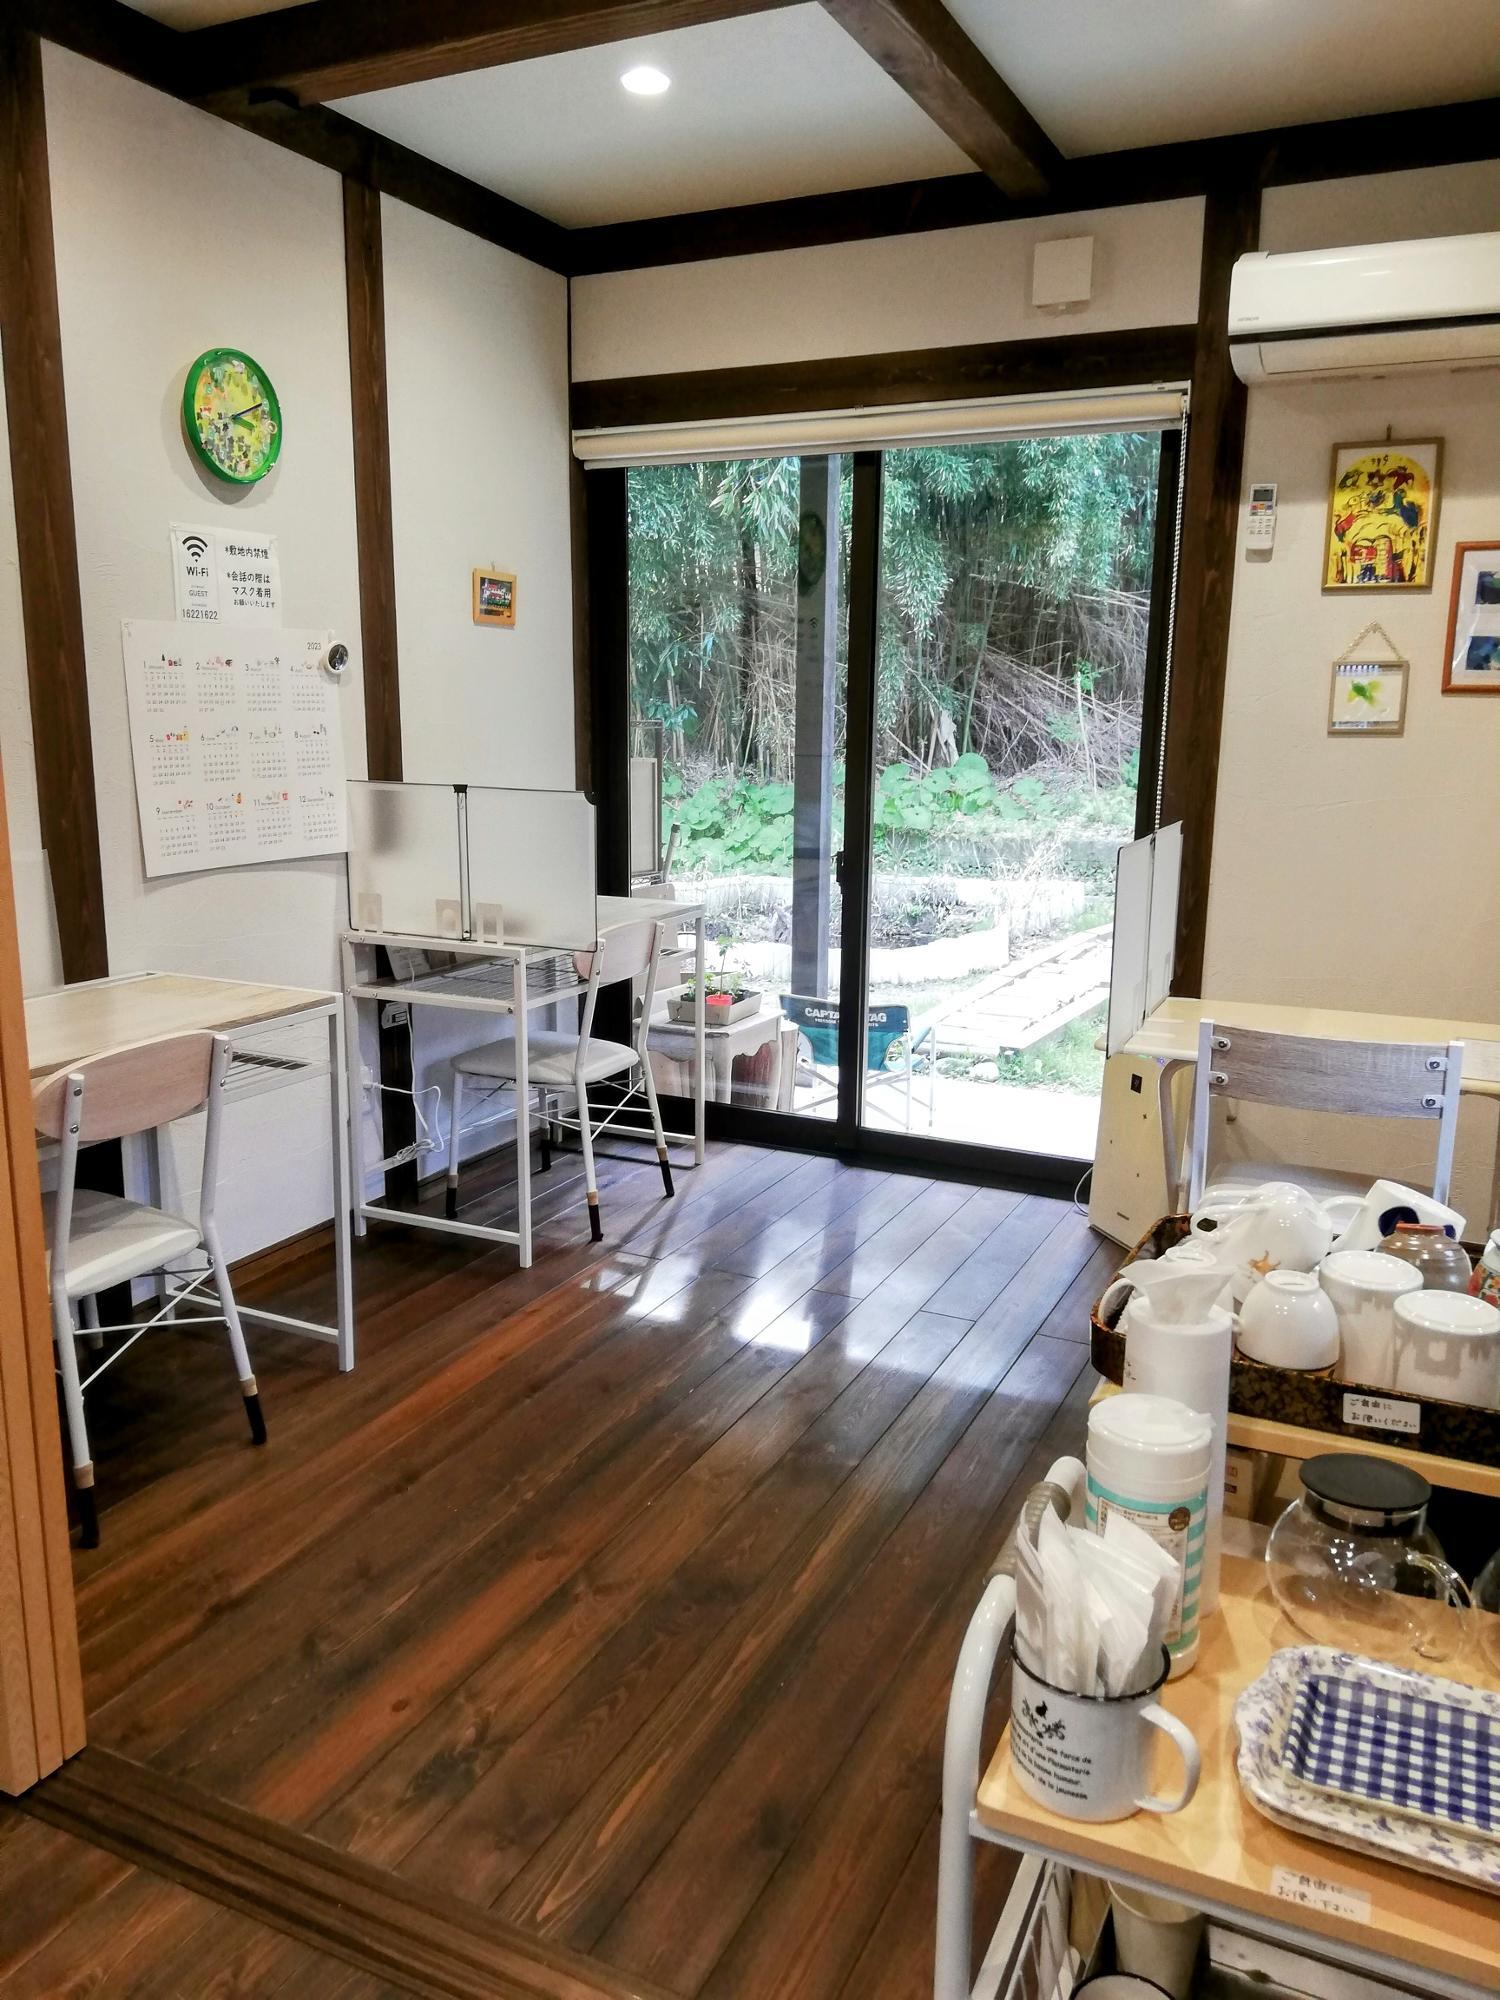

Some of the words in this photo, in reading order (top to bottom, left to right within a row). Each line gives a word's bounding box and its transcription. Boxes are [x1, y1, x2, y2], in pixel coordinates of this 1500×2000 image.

[186, 566, 209, 577] Wi-Fi
[188, 590, 208, 598] GUEST
[232, 586, 272, 599] マスク着用
[182, 608, 218, 620] 16221622
[306, 642, 322, 651] 2023
[805, 1007, 839, 1018] CAPTA
